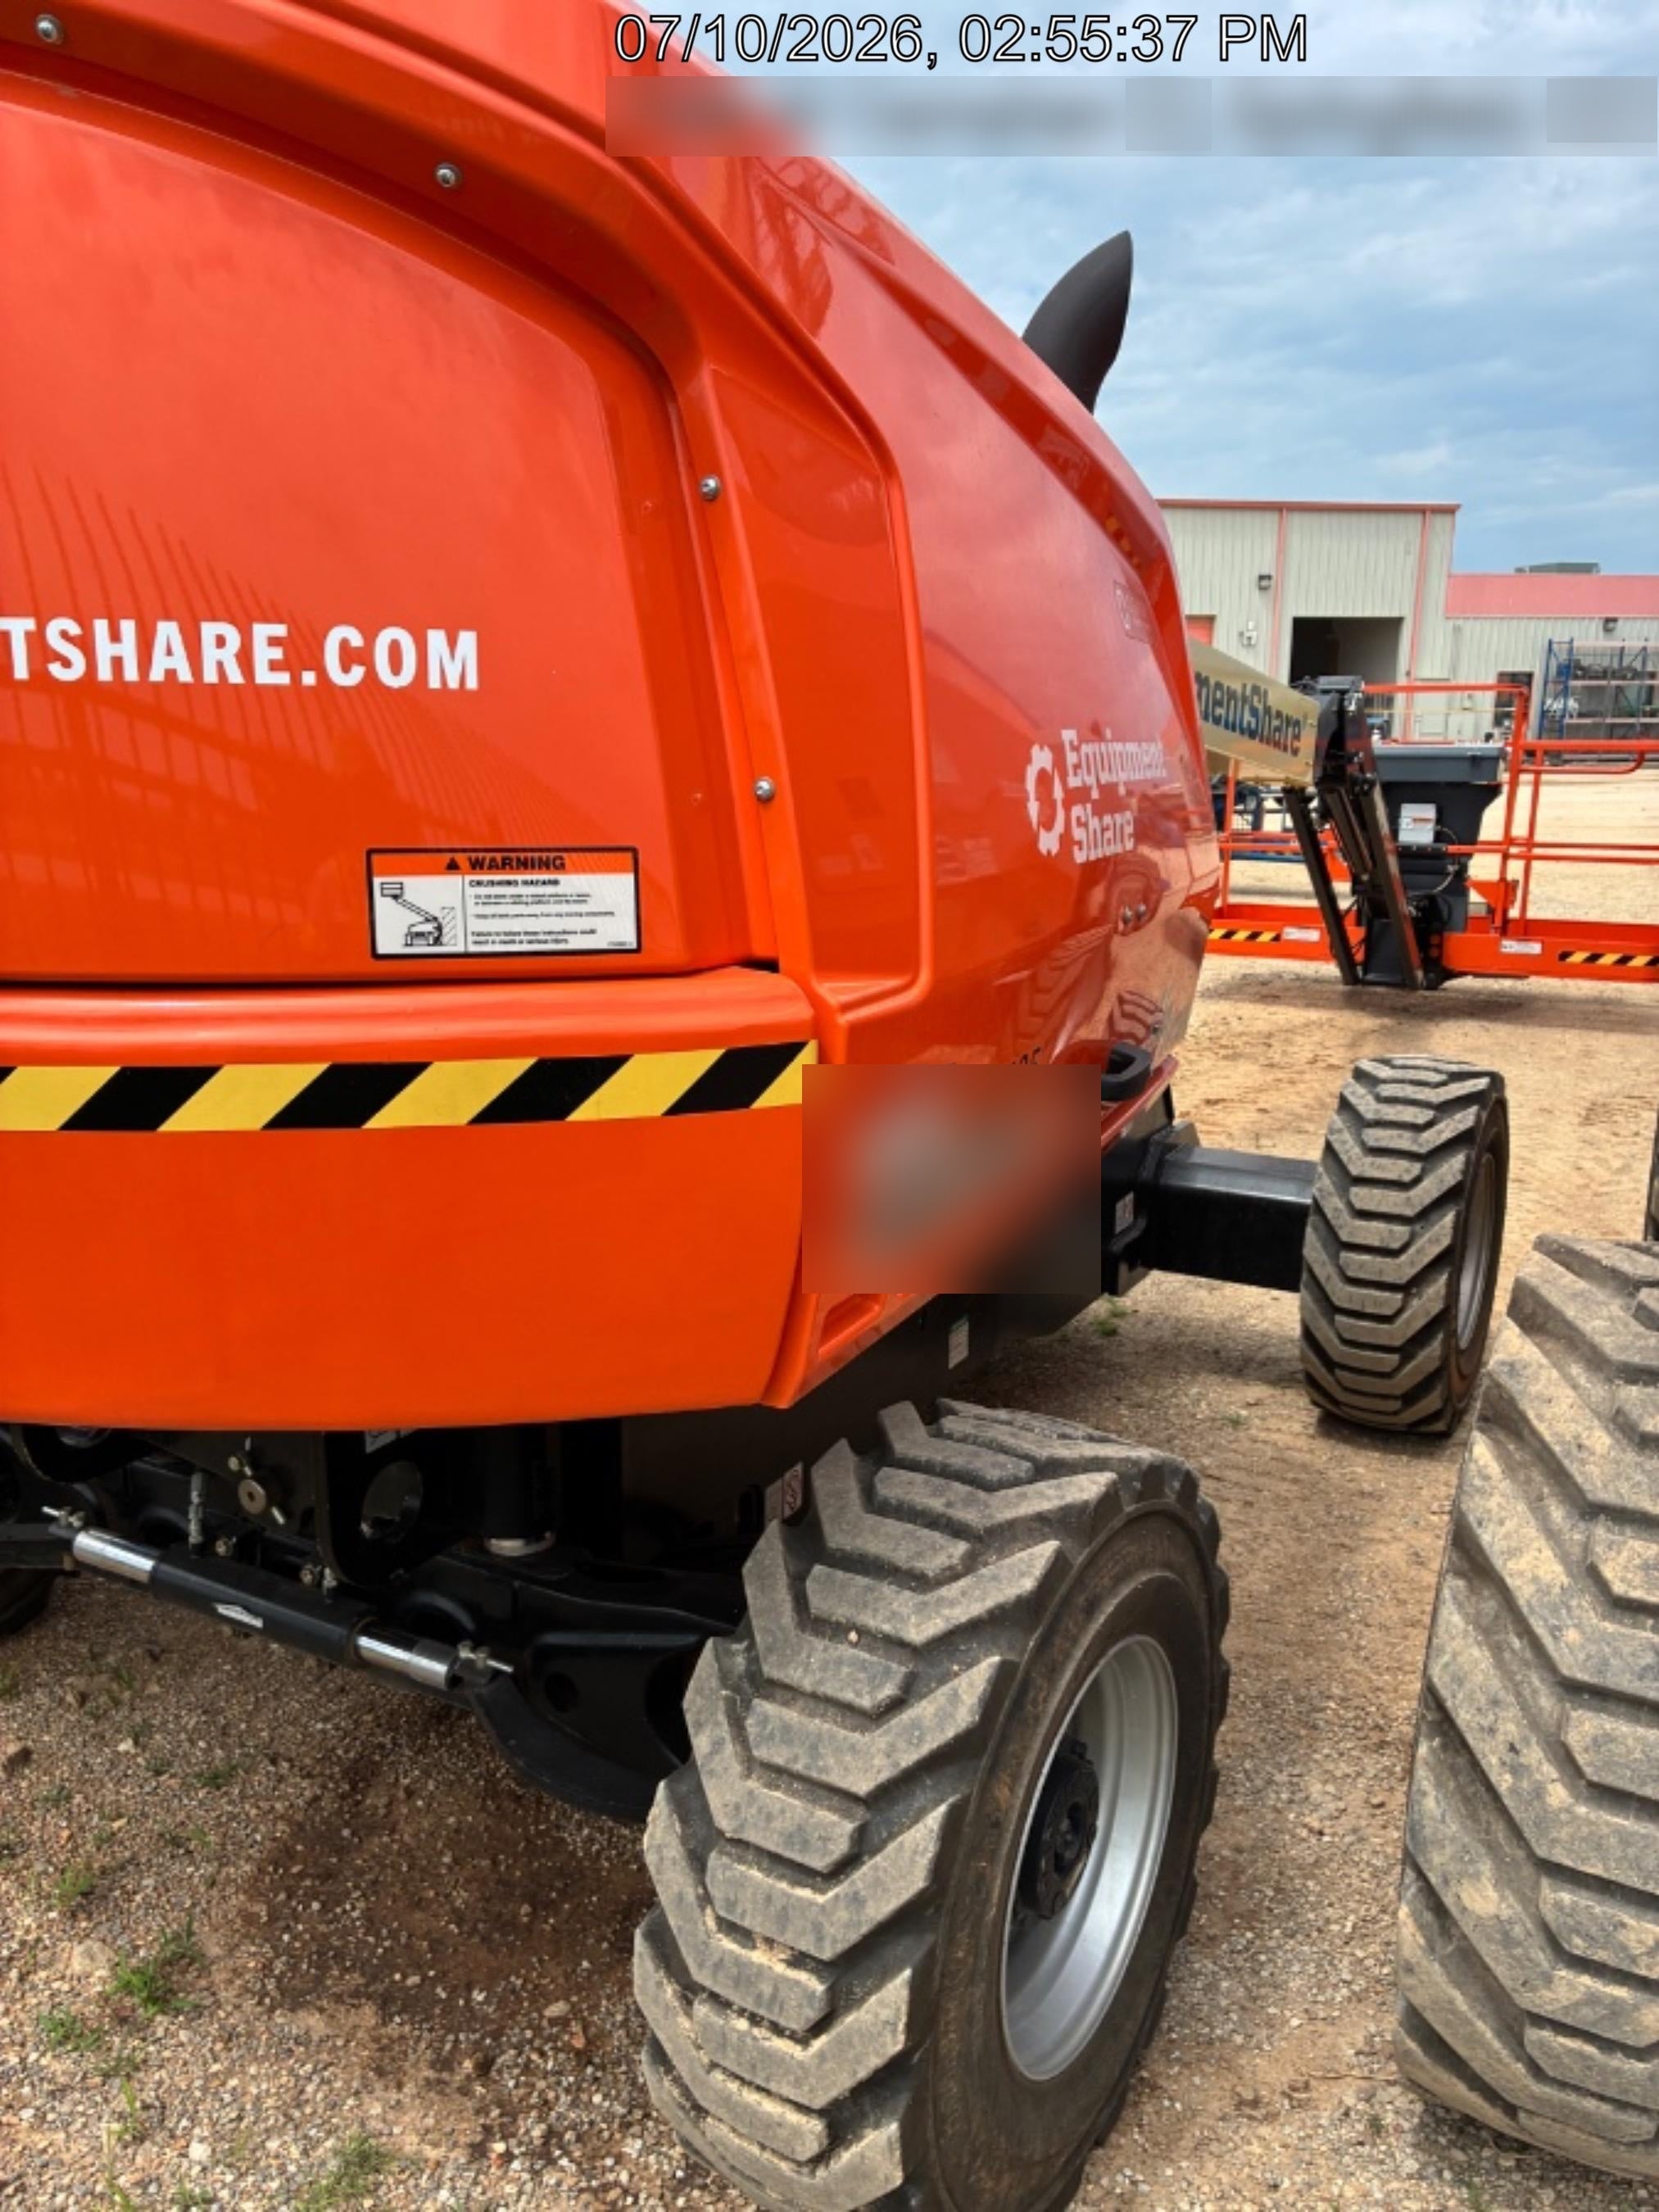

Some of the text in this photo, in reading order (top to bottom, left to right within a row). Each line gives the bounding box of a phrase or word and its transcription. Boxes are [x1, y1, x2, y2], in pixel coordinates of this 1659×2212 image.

[0, 616, 479, 691] TSHARE.COM
[1062, 727, 1167, 800] Equipment
[468, 854, 566, 872] WARNING
[1071, 802, 1135, 863] Share
[469, 877, 561, 888] CRUSHING HAZARD
